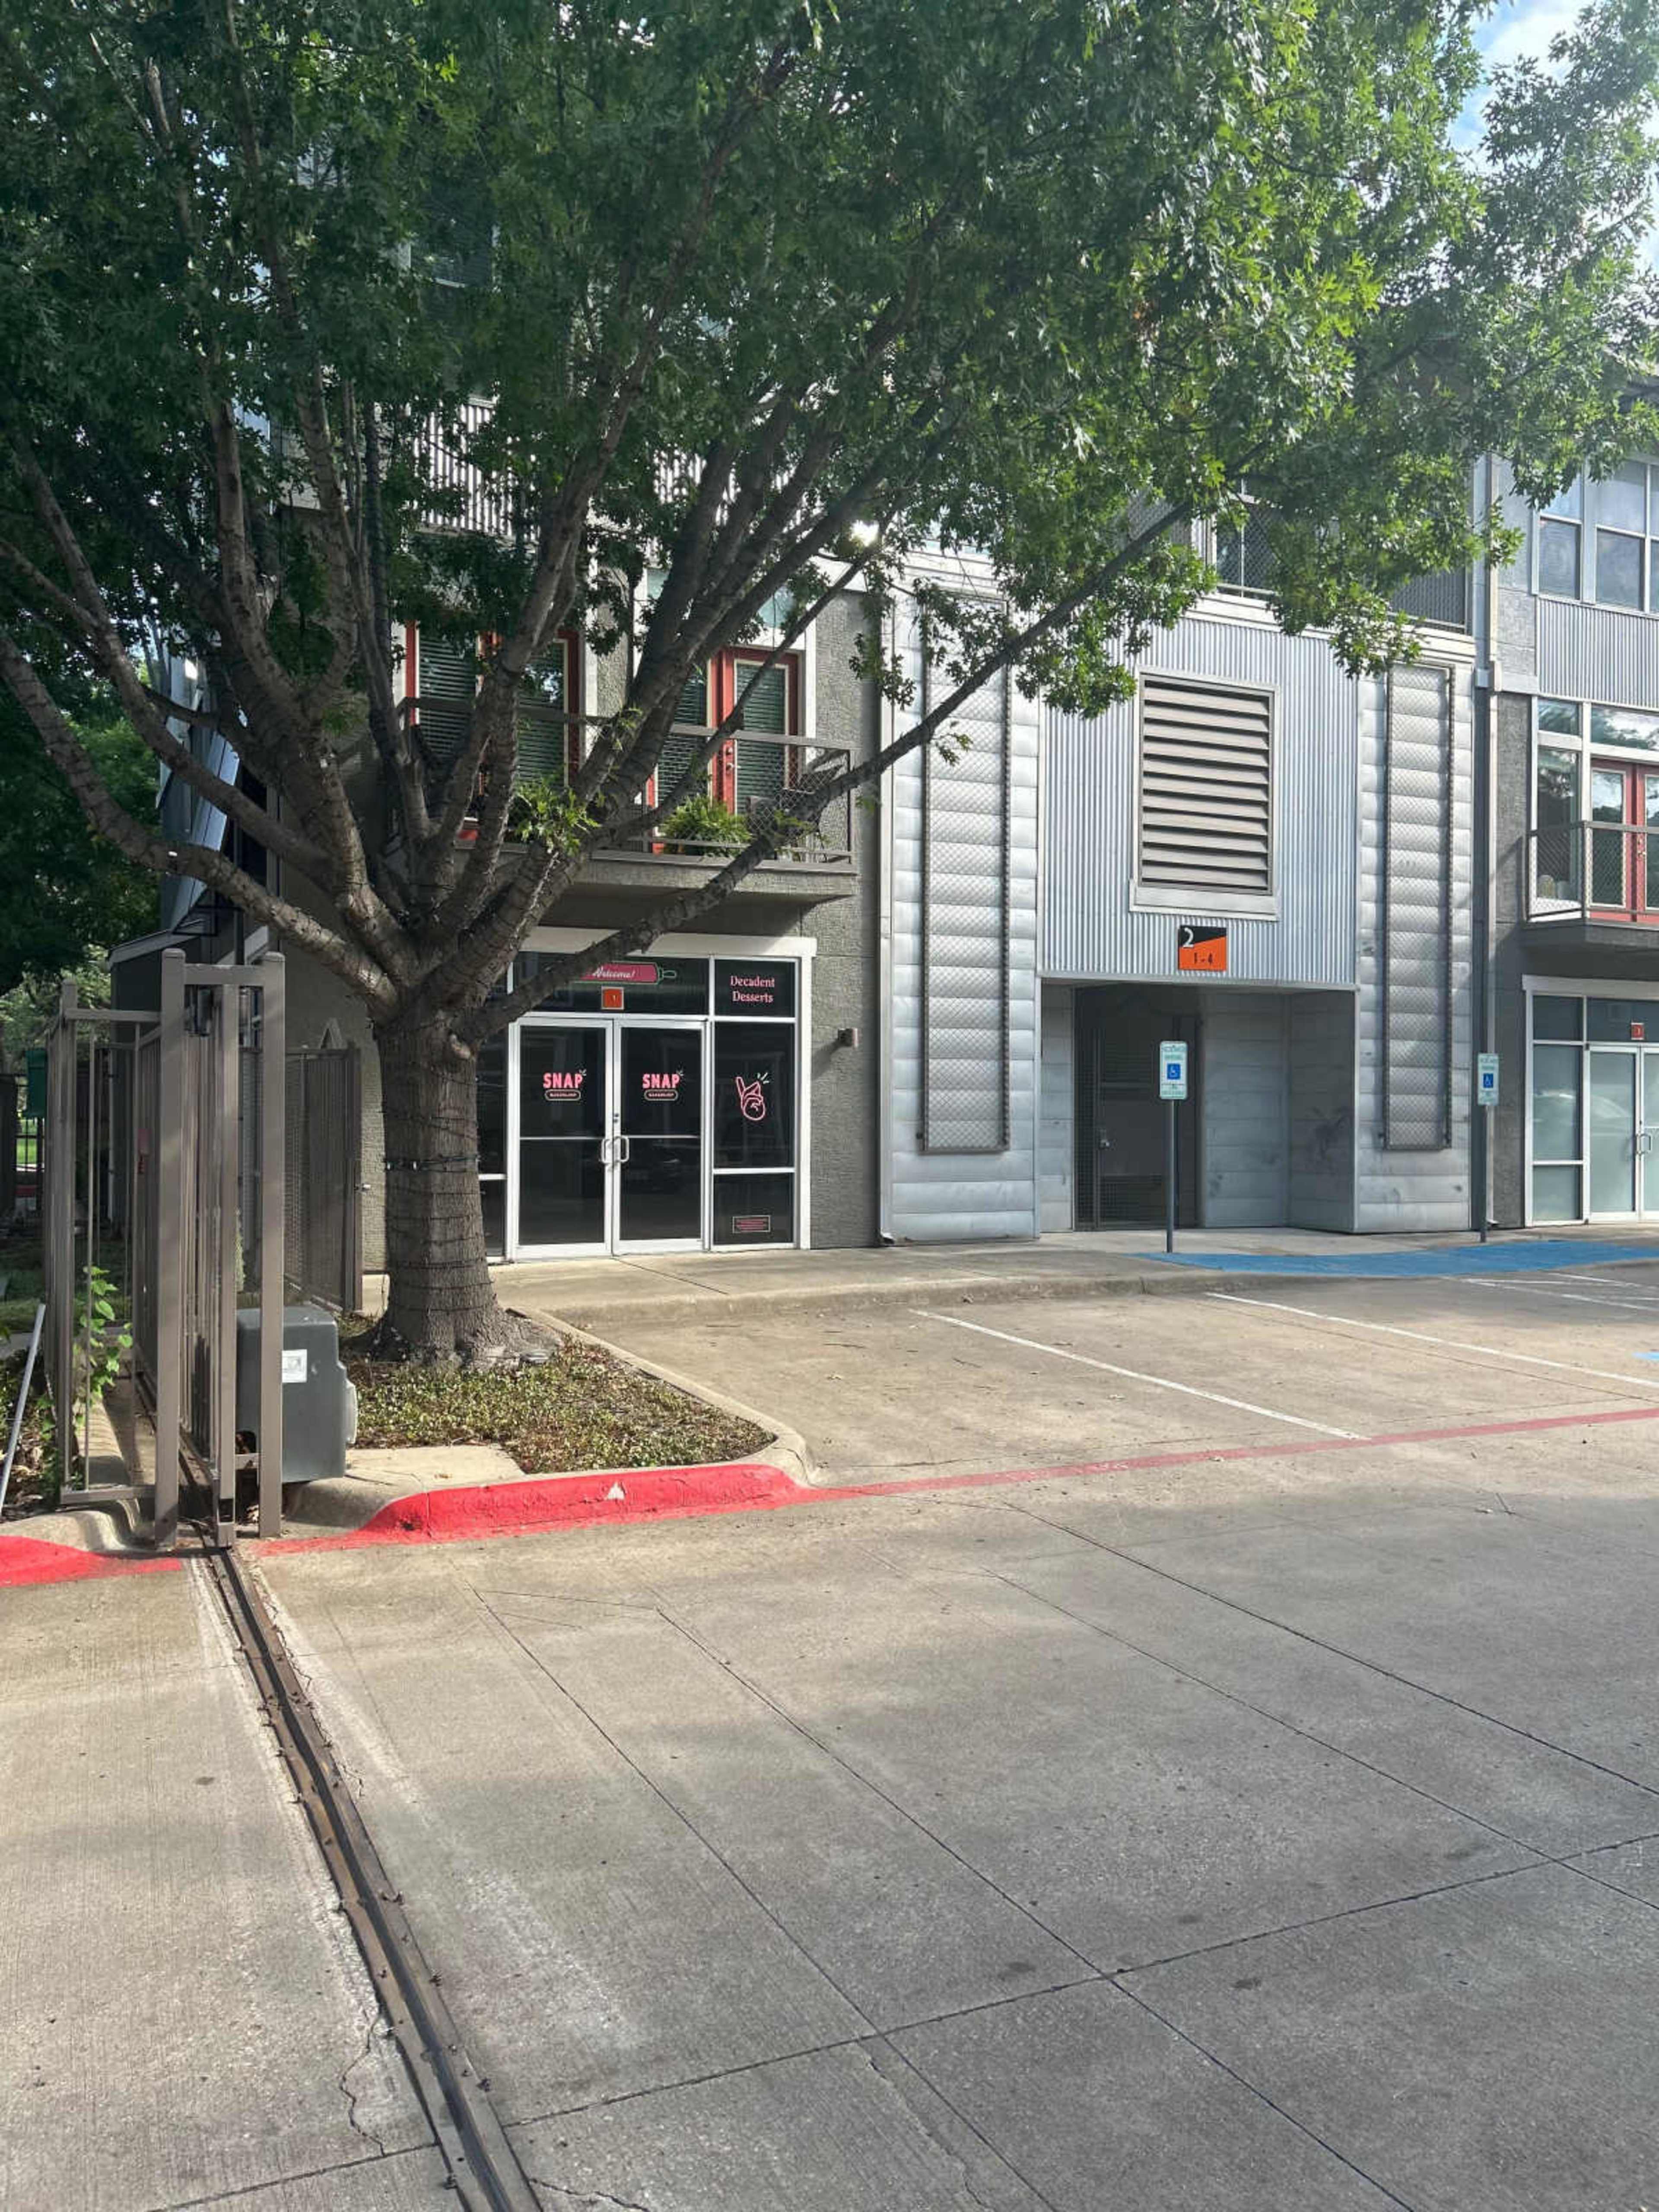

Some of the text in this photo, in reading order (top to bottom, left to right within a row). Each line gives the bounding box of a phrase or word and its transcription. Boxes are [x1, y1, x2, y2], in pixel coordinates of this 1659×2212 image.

[1183, 927, 1194, 947] 2
[730, 975, 775, 988] Decadent
[732, 991, 773, 1003] Desserts
[543, 1072, 583, 1089] SNAP
[642, 1073, 680, 1089] SNAP
